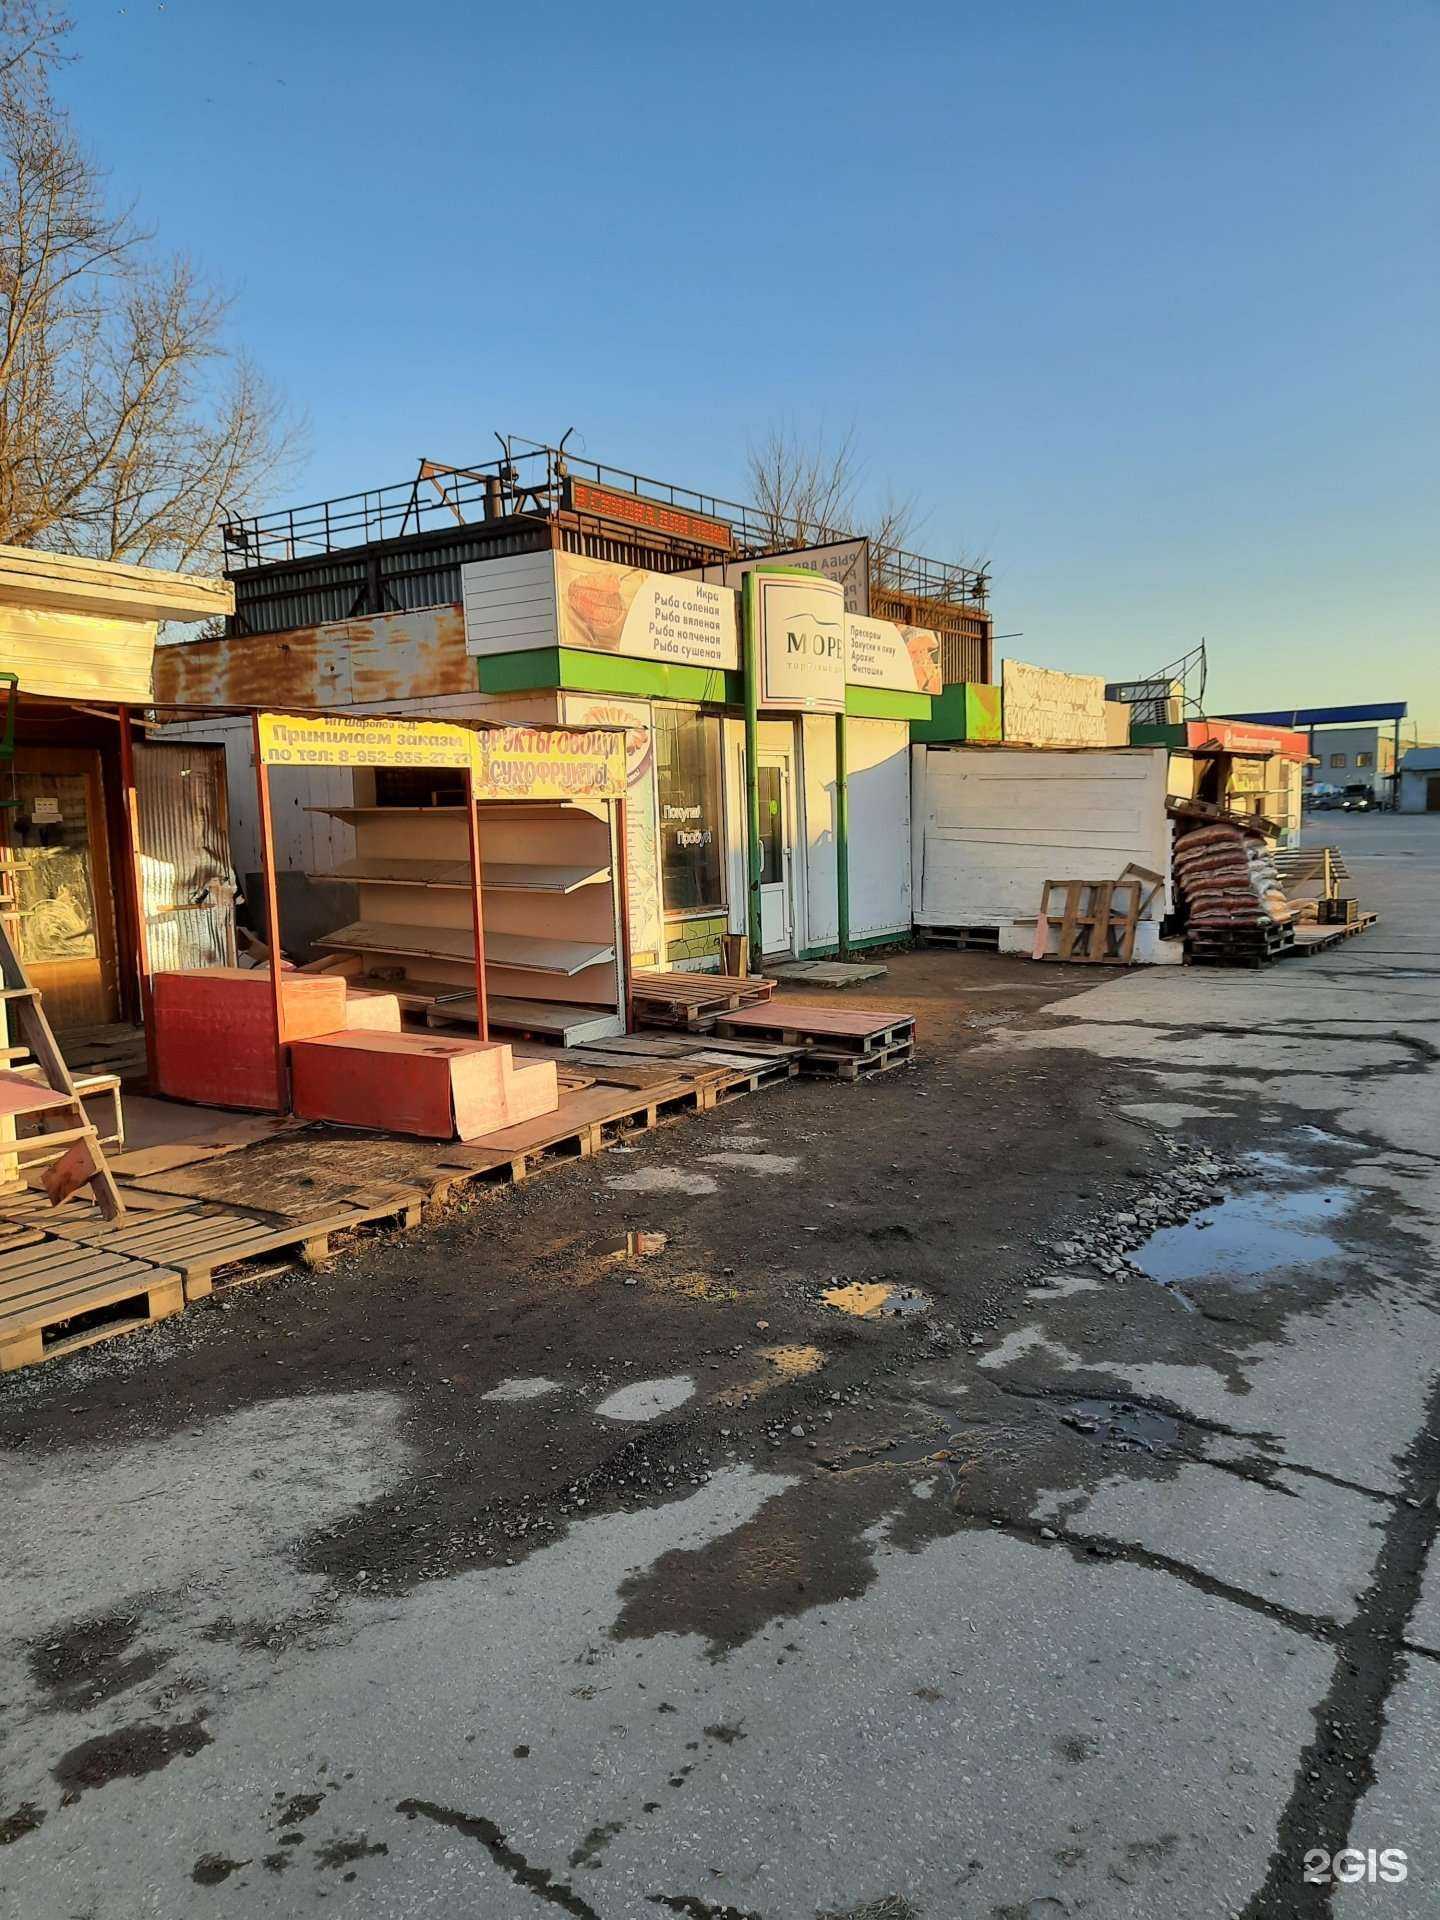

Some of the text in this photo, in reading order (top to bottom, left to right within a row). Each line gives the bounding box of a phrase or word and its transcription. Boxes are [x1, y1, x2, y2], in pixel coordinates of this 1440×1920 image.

[654, 592, 720, 616] Рыба соленая
[696, 585, 719, 603] Икра
[655, 607, 721, 630] Рыба вяленая
[649, 622, 721, 645] Рыба копченая
[653, 638, 721, 660] Рыба сушеная
[786, 631, 842, 660] МОРЕ
[272, 725, 464, 747] Принимаем заказы
[268, 749, 292, 761] по
[299, 750, 334, 762] тел:
[489, 760, 608, 785] СУХОФРУКТЫ
